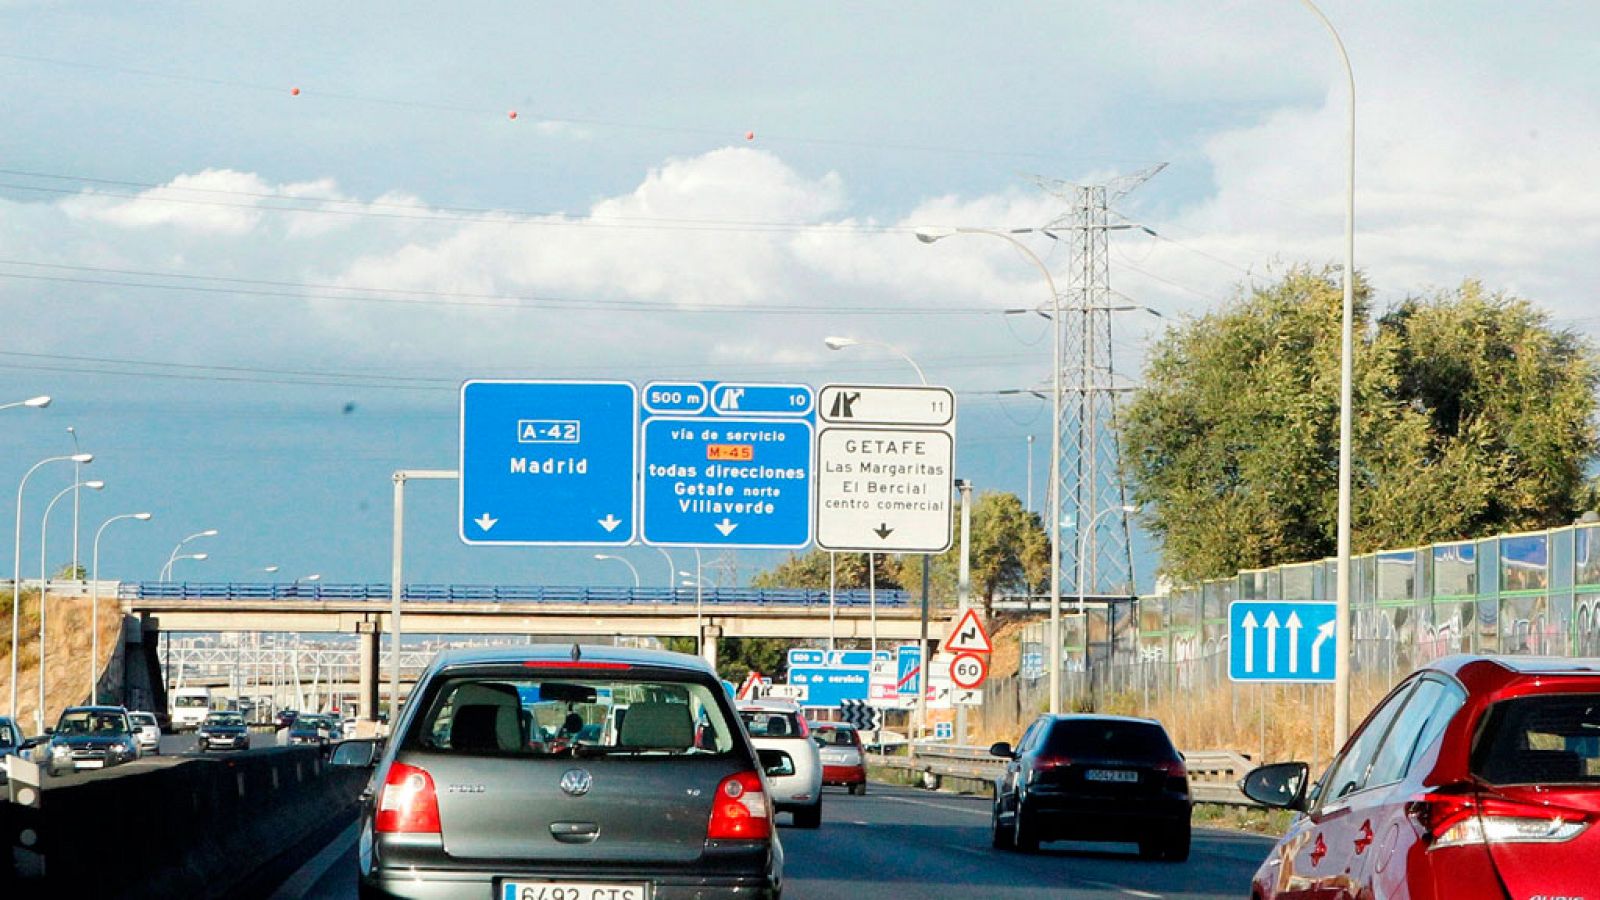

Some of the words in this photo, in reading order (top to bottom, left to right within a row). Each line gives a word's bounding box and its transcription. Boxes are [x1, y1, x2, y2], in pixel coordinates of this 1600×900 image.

[652, 391, 682, 404] 500
[687, 394, 700, 404] m
[789, 394, 806, 406] 10
[930, 401, 944, 413] 11
[521, 424, 577, 440] A-42
[701, 429, 719, 441] de
[726, 430, 786, 442] servicio
[708, 446, 752, 459] M-45
[845, 440, 927, 456] GETAFE
[509, 456, 589, 475] Madrid
[648, 464, 698, 478] todas
[705, 464, 805, 480] direcciones
[825, 460, 853, 473] Las
[859, 461, 945, 477] Margaritas
[674, 482, 734, 497] Getafe
[743, 486, 781, 498] norte
[843, 480, 859, 493] El
[867, 480, 927, 495] Bercial
[678, 499, 775, 515] Villaverde
[825, 498, 870, 510] centro
[877, 500, 944, 512] comercial
[957, 664, 979, 676] 60
